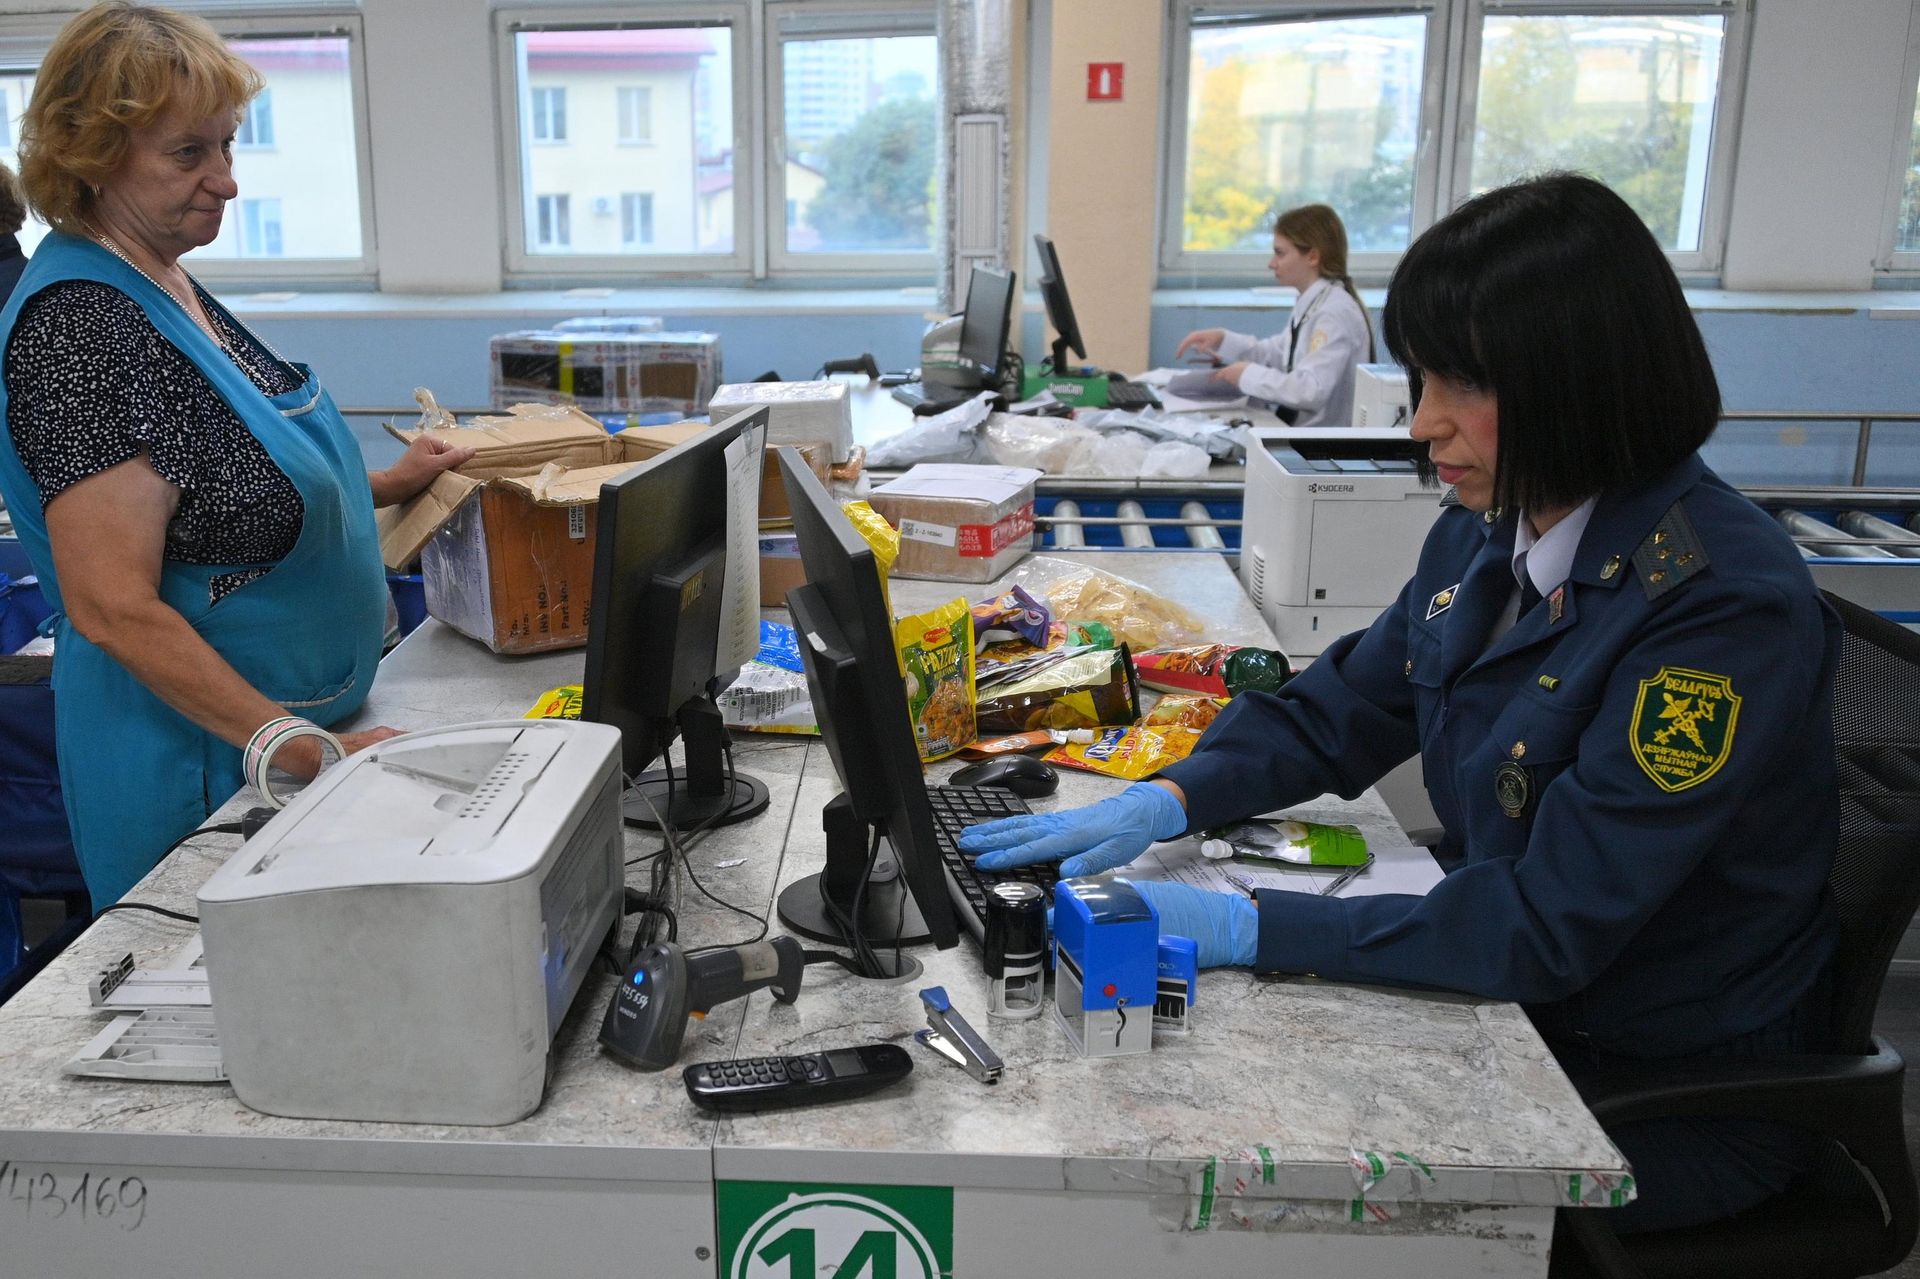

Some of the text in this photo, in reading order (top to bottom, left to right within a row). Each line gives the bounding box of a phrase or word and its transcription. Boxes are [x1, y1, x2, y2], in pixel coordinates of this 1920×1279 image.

[1318, 484, 1354, 493] KYOCERA
[561, 606, 570, 629] Part
[1664, 678, 1722, 699] БЕЛАРУСЬ
[1654, 754, 1698, 769] МЫТНАЯ
[1653, 763, 1695, 777] СЛУЖБА
